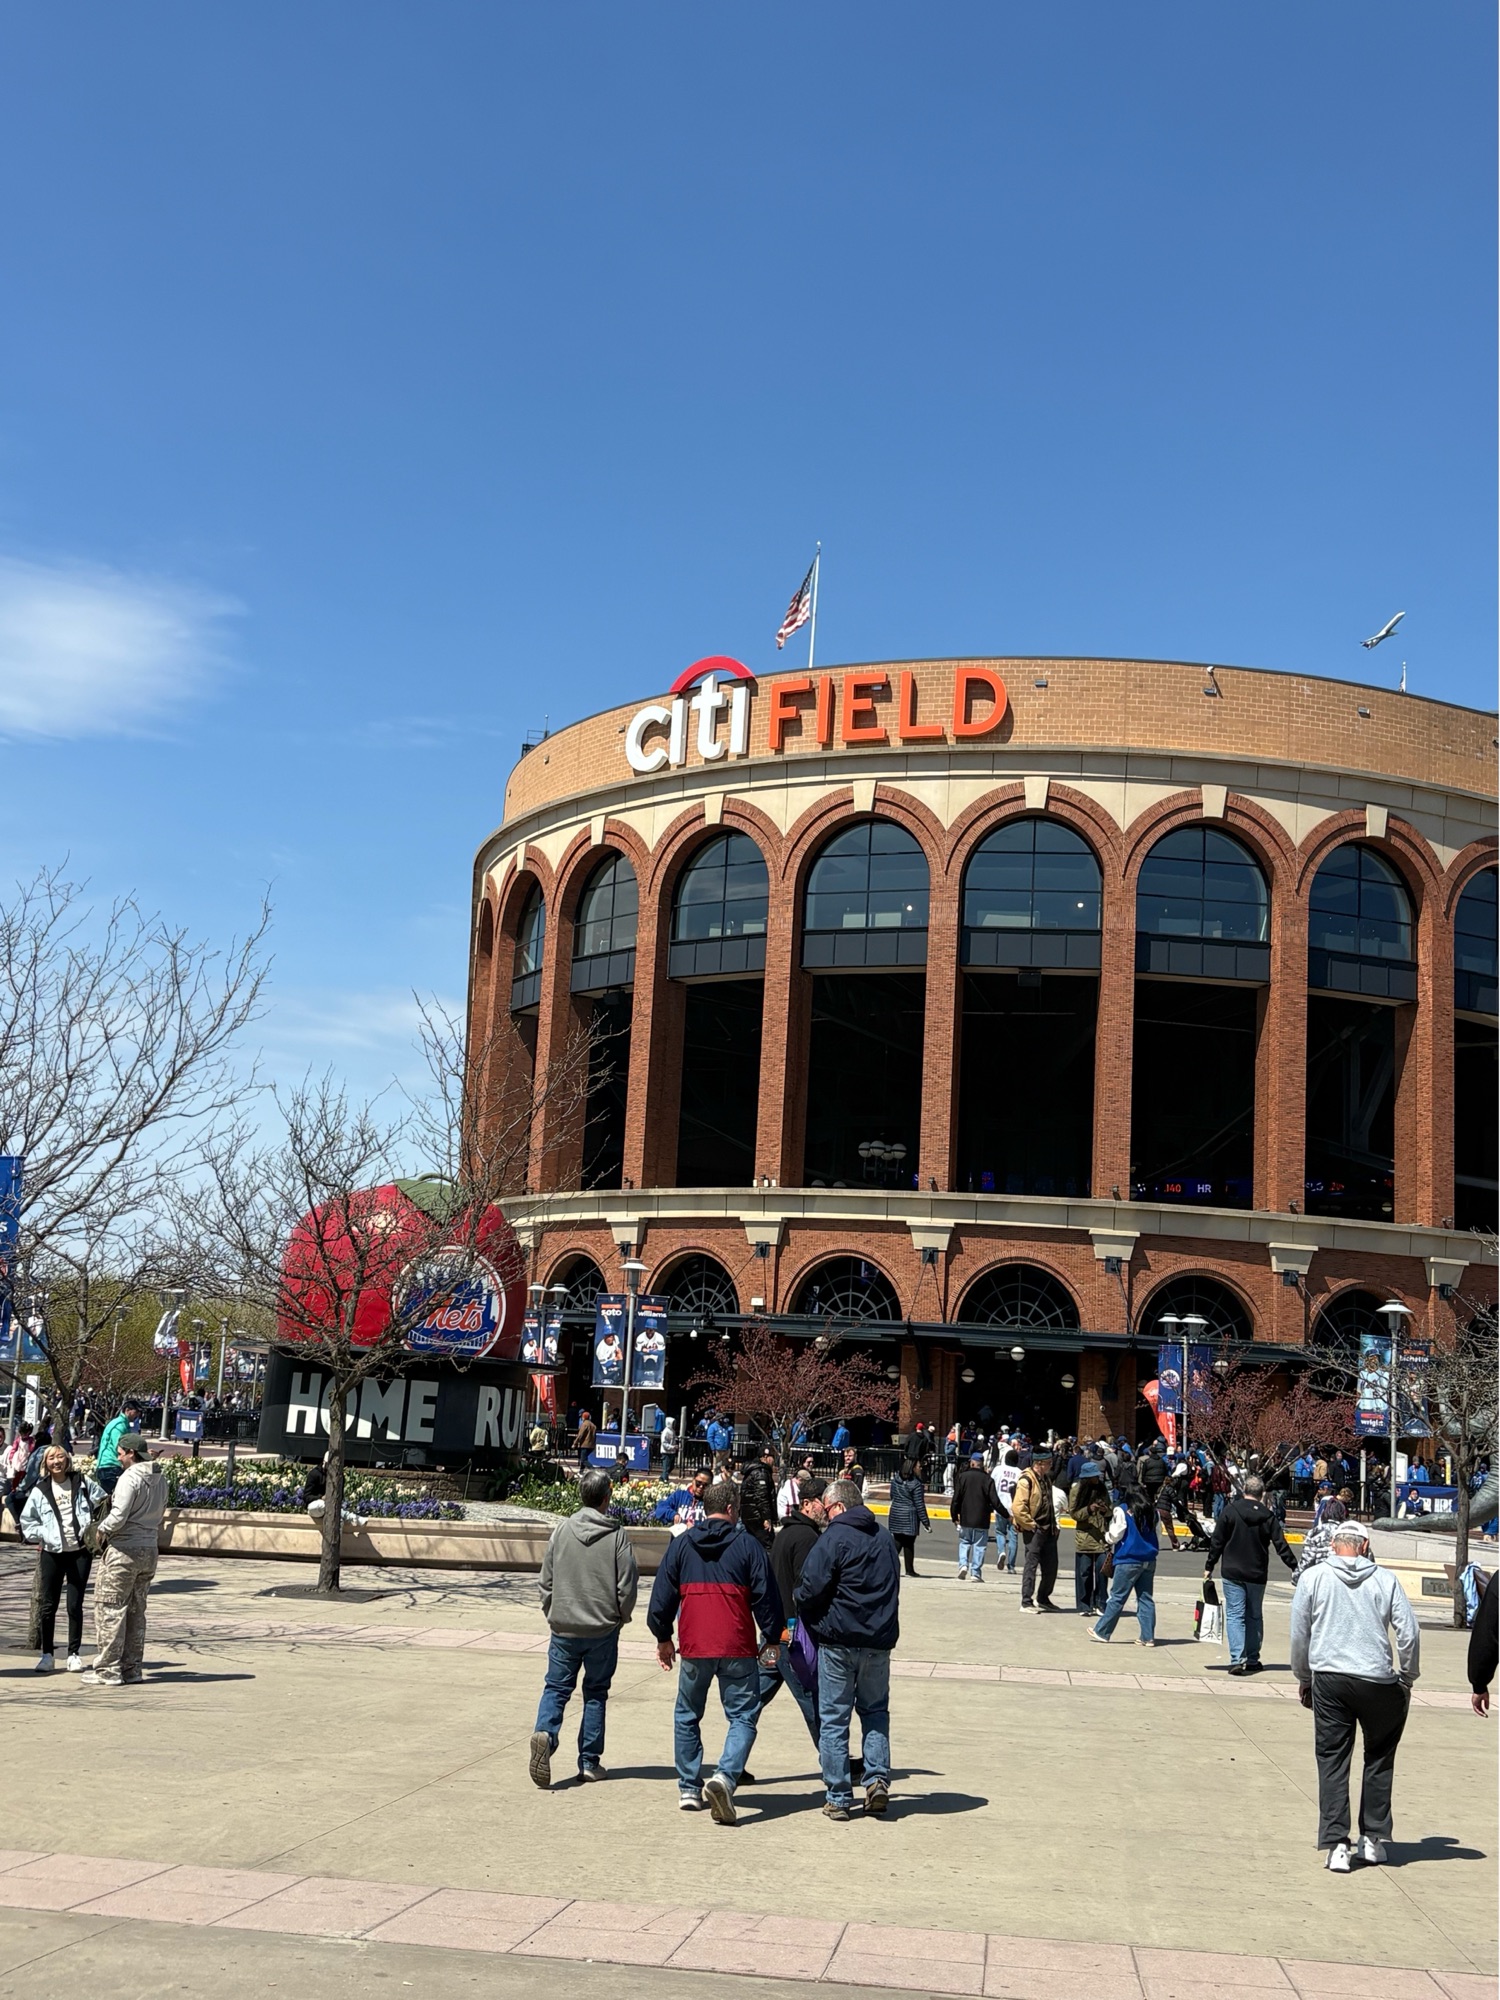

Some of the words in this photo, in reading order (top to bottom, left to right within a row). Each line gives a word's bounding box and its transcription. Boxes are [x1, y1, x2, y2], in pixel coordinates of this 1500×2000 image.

[625, 670, 752, 772] citi
[768, 668, 1008, 750] FIELD
[1197, 1184, 1212, 1193] HR
[286, 1372, 440, 1443] HOME
